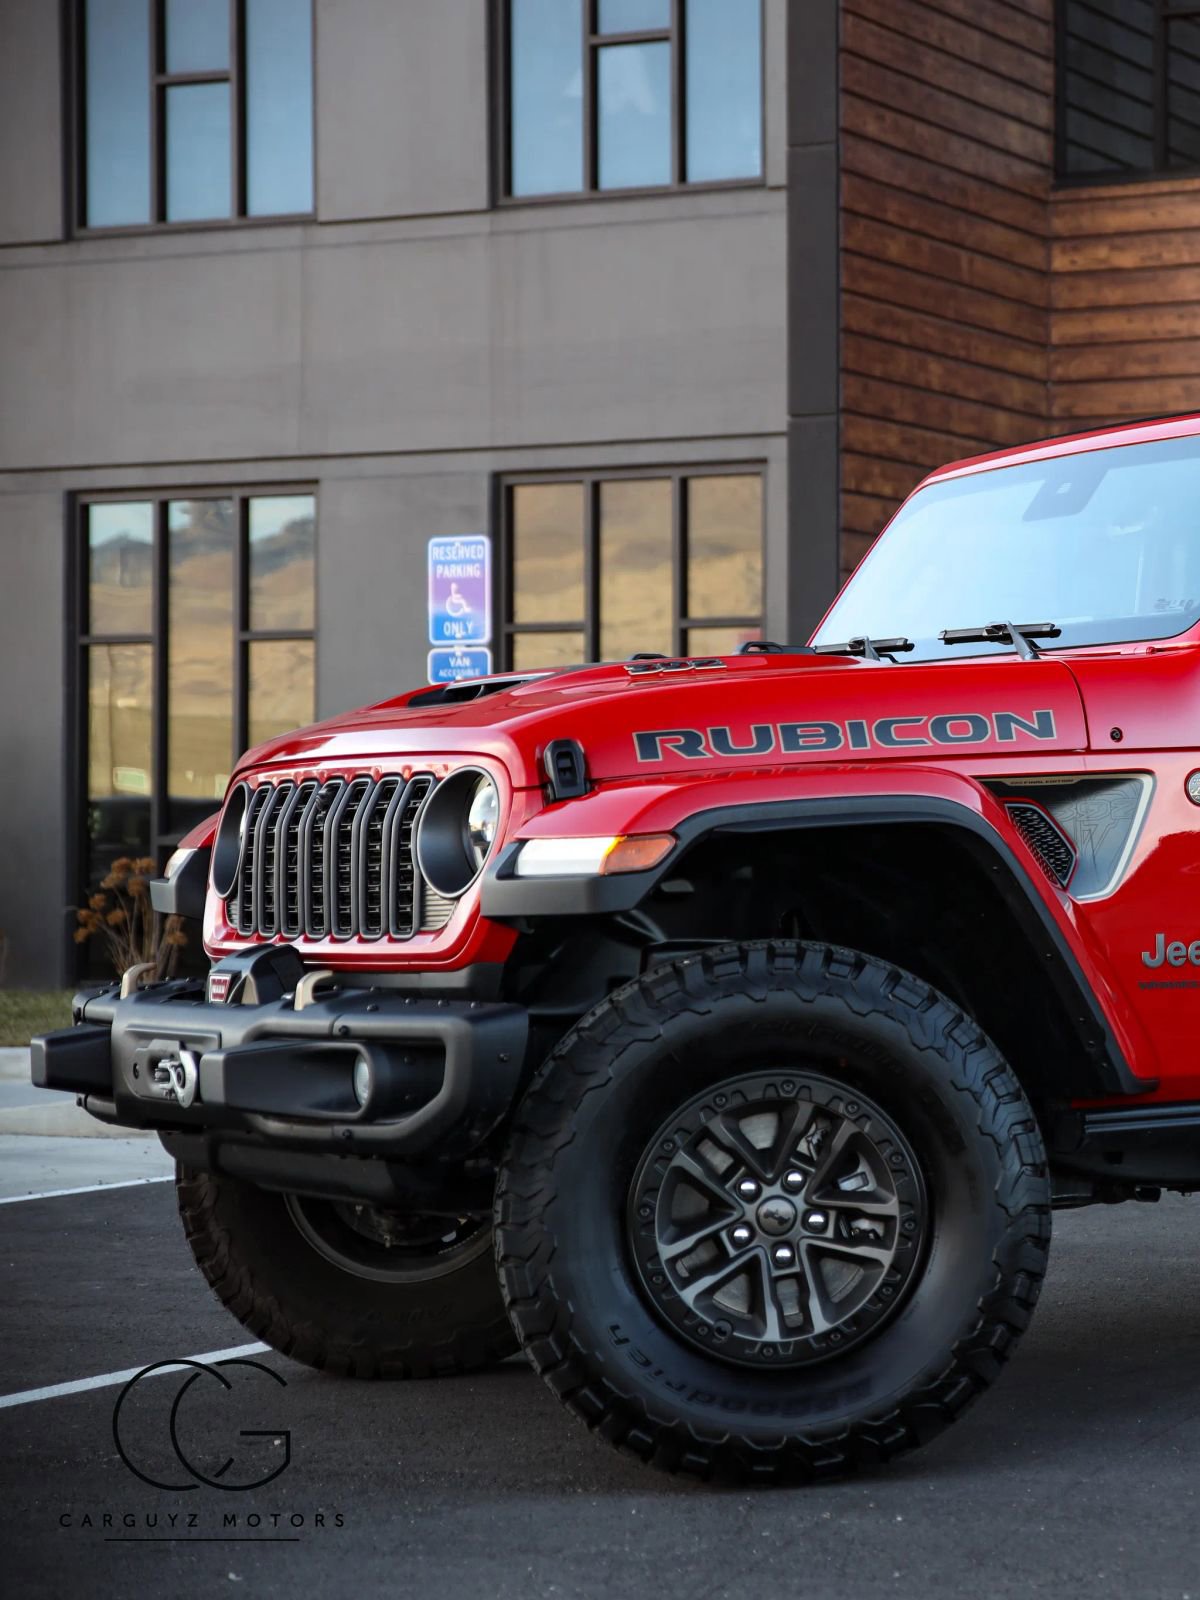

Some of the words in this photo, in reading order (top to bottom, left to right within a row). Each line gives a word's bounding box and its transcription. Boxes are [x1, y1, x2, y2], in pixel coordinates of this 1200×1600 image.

[432, 545, 484, 561] RESERVED
[436, 563, 481, 579] PARKING
[443, 621, 474, 637] ONLY
[449, 656, 471, 668] VAN
[631, 709, 1057, 763] RUBICON
